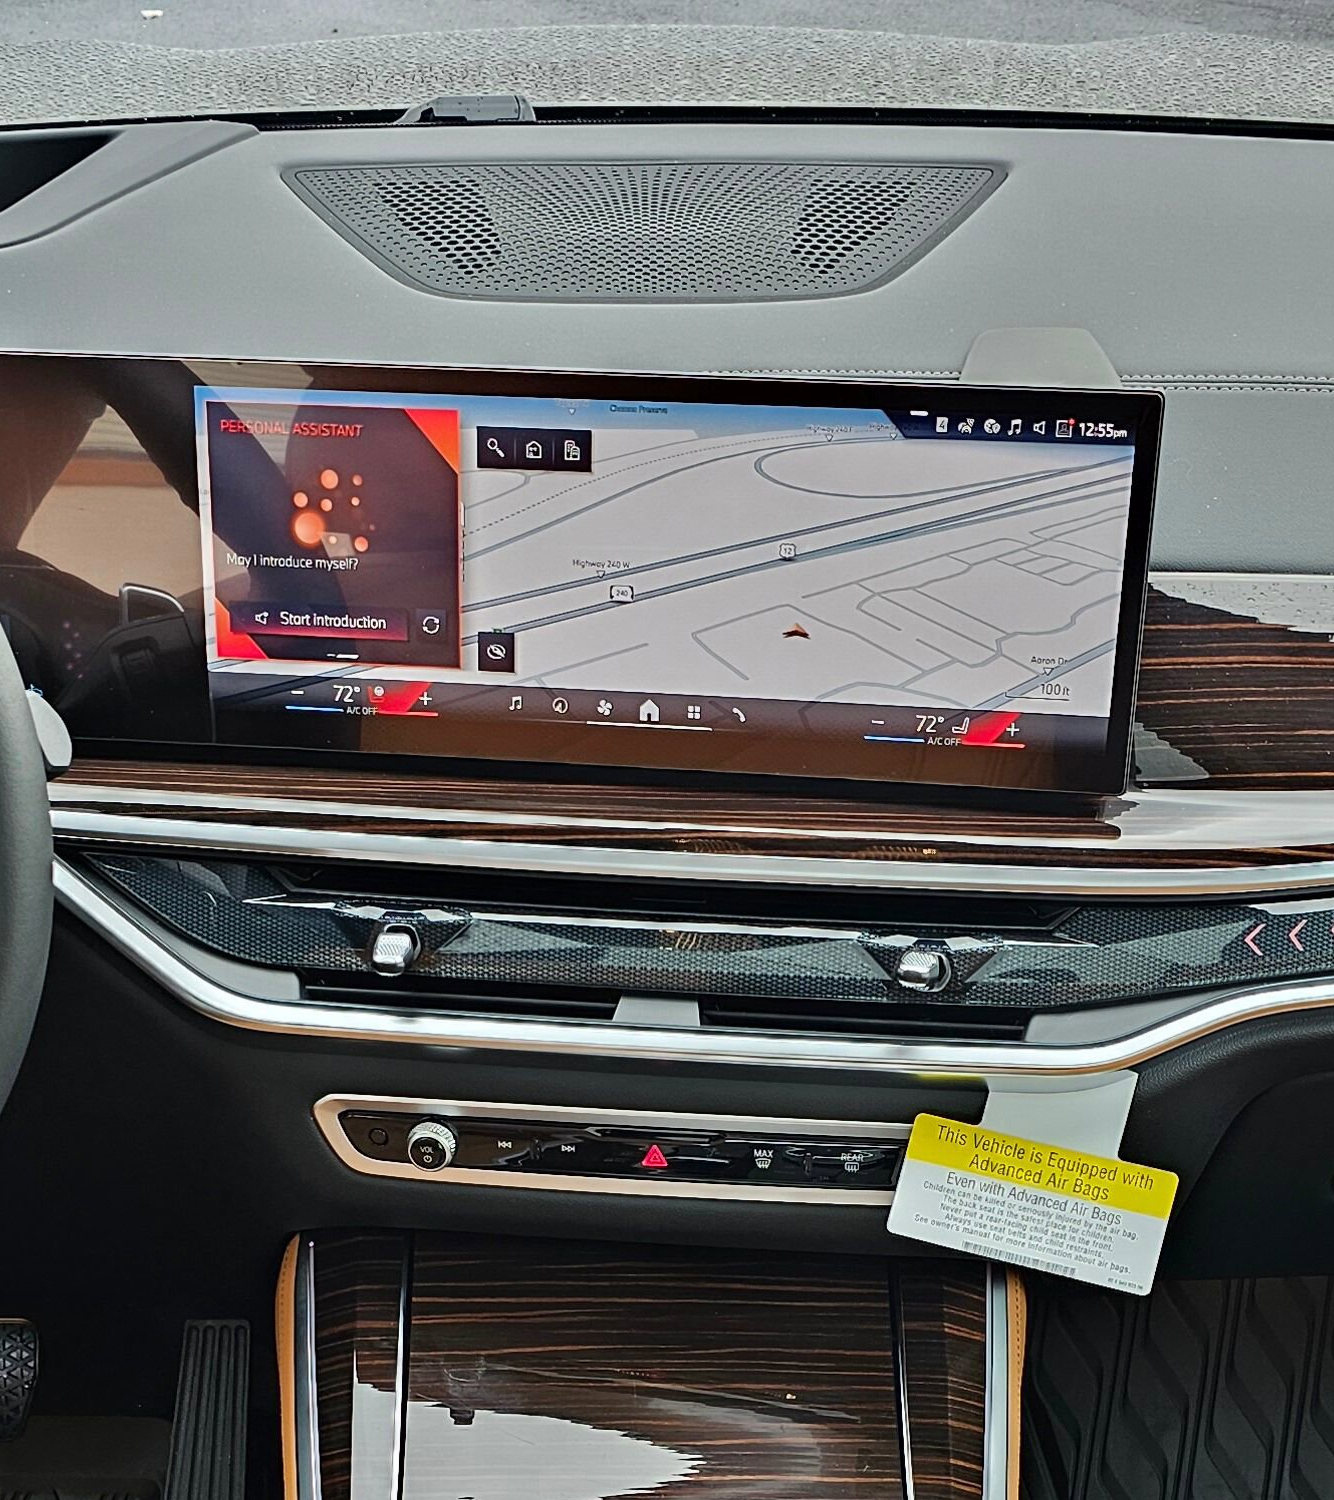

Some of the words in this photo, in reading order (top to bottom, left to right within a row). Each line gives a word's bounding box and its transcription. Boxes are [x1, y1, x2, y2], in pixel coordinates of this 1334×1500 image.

[220, 420, 289, 434] PERSONAL
[292, 423, 363, 437] ASSISTANT
[226, 553, 251, 568] May
[253, 556, 257, 566] I
[259, 555, 313, 568] introduce
[315, 558, 359, 571] myself?
[572, 559, 605, 569] Highway
[607, 560, 621, 569] 240
[279, 611, 311, 627] Start
[313, 613, 387, 630] introduction
[1030, 656, 1056, 665] Aaron
[1040, 683, 1062, 696] 100
[347, 706, 361, 715] A/C
[361, 706, 378, 716] OFF
[927, 736, 943, 746] A/C
[944, 737, 962, 747] OFF
[419, 1145, 434, 1154] VOL
[753, 1149, 774, 1158] MAX
[841, 1153, 864, 1161] REAR
[936, 1124, 969, 1146] This
[971, 1133, 1026, 1160] Vehicle
[1029, 1148, 1044, 1164] is
[1047, 1151, 1118, 1185] Equipped
[1122, 1170, 1154, 1191] with
[969, 1153, 1043, 1185] Advanced
[1046, 1172, 1069, 1190] Air
[1072, 1178, 1110, 1203] Bags
[947, 1171, 977, 1190] Even
[978, 1179, 1006, 1197] with
[1007, 1186, 1068, 1212] Advanced
[1070, 1202, 1089, 1217] Air
[1090, 1207, 1123, 1227] Bags
[923, 1181, 956, 1195] Children
[957, 1190, 971, 1199] can
[1095, 1223, 1107, 1232] the
[1110, 1227, 1120, 1235] air
[1122, 1230, 1139, 1241] bag.
[943, 1195, 957, 1204] The
[1006, 1210, 1018, 1219] the
[1068, 1226, 1079, 1234] for
[940, 1203, 961, 1214] Never
[964, 1209, 977, 1219] put
[1029, 1225, 1049, 1236] child
[1078, 1237, 1090, 1246] the
[945, 1213, 971, 1226] Always
[973, 1221, 987, 1229] use
[1029, 1234, 1042, 1243] and
[1044, 1238, 1064, 1248] child
[914, 1214, 928, 1224] See
[962, 1226, 990, 1239] manual
[992, 1234, 1004, 1242] for
[1006, 1238, 1026, 1248] more
[1075, 1254, 1095, 1265] about
[1097, 1260, 1108, 1268] air
